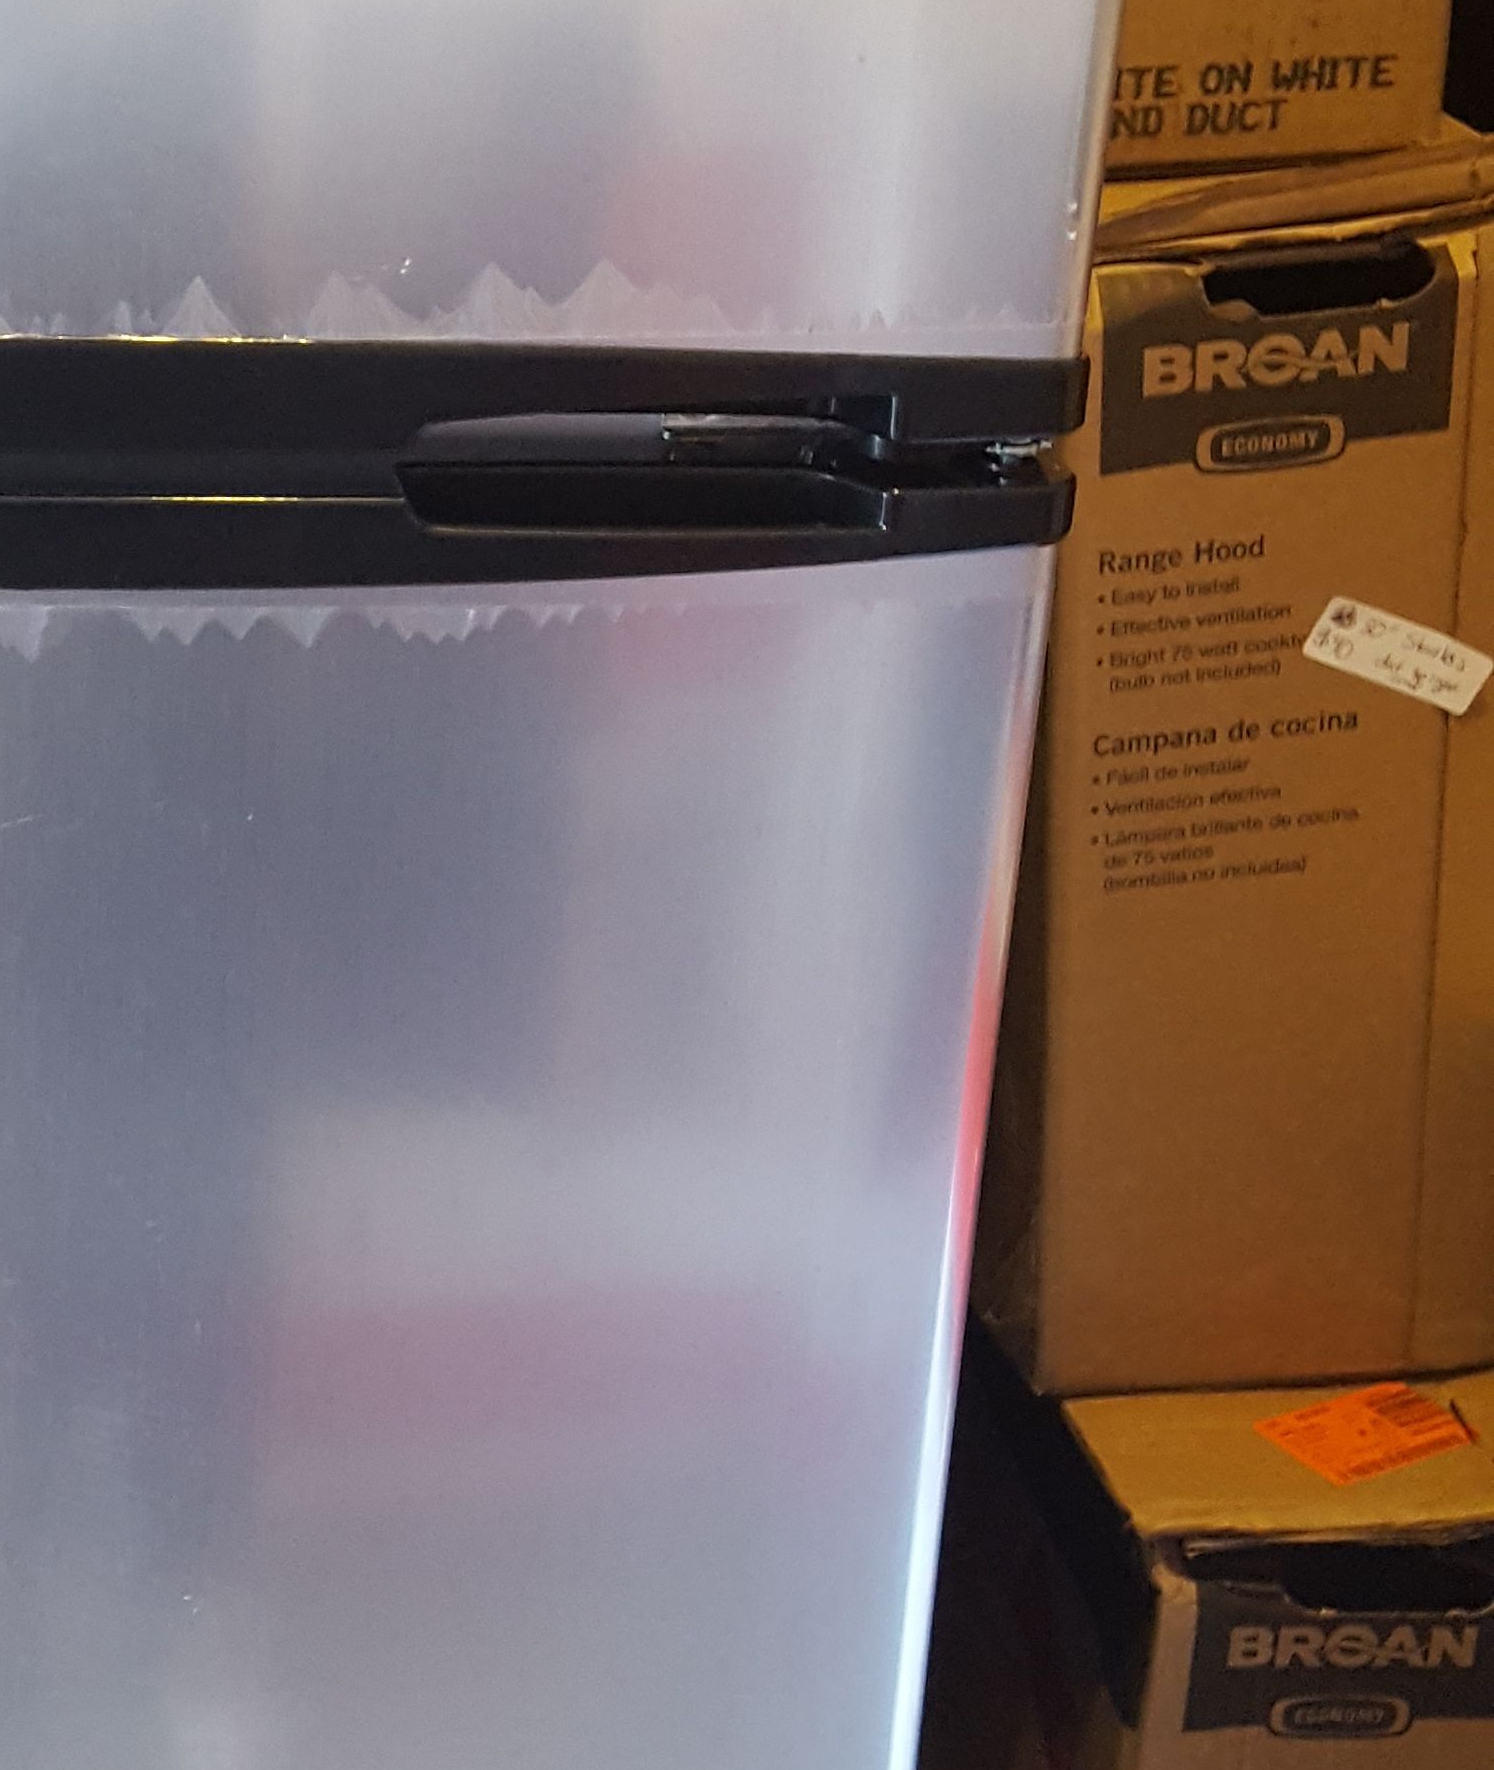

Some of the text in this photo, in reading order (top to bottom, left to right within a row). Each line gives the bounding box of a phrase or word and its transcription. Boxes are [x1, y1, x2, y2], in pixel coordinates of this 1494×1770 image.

[1113, 54, 1400, 100] ITE ON WHITE
[1109, 98, 1289, 140] ND DUCT
[1141, 322, 1411, 399] BROAN
[1221, 430, 1320, 459] ECONOMY
[1098, 534, 1266, 575] Range Hood
[1111, 576, 1240, 607] Easy to install
[1110, 604, 1293, 638] Effective ventilation
[1109, 648, 1165, 670] Bright
[1198, 640, 1239, 660] watt
[1109, 660, 1282, 694] (bulb not included)
[1093, 709, 1359, 757] Campana de cocina
[1155, 764, 1178, 781] de
[1182, 757, 1251, 779] instalar
[1209, 785, 1283, 808] efectiva
[1268, 812, 1292, 829] de
[1297, 805, 1361, 826] cocina
[1132, 850, 1155, 866] 75
[1159, 844, 1215, 866] vatios
[1225, 1625, 1479, 1669] BROAN
